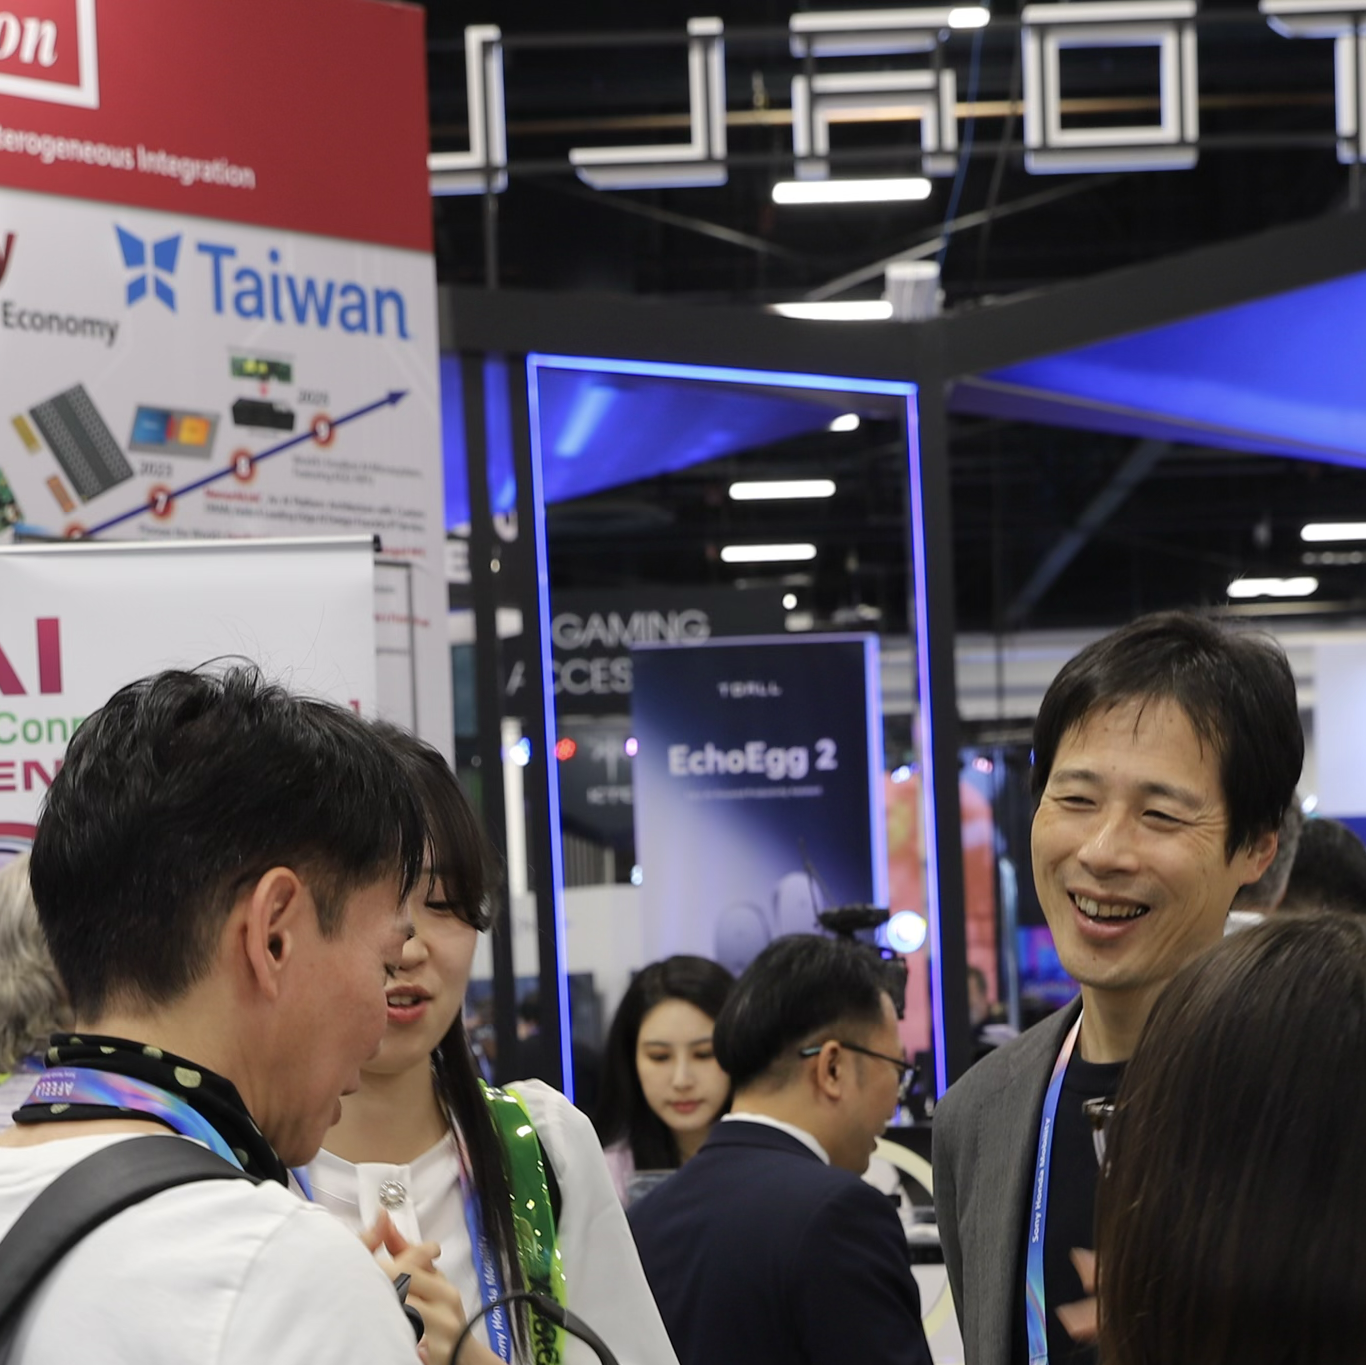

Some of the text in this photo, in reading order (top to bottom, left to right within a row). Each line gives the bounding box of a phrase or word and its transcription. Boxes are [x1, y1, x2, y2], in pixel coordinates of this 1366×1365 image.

[137, 143, 255, 190] Integration
[197, 241, 410, 340] Taiwan
[3, 303, 119, 346] Economy
[552, 610, 710, 650] GAMING
[668, 739, 838, 780] EchoEgg 2
[1032, 1117, 1051, 1243] Sony Honda Mobility
